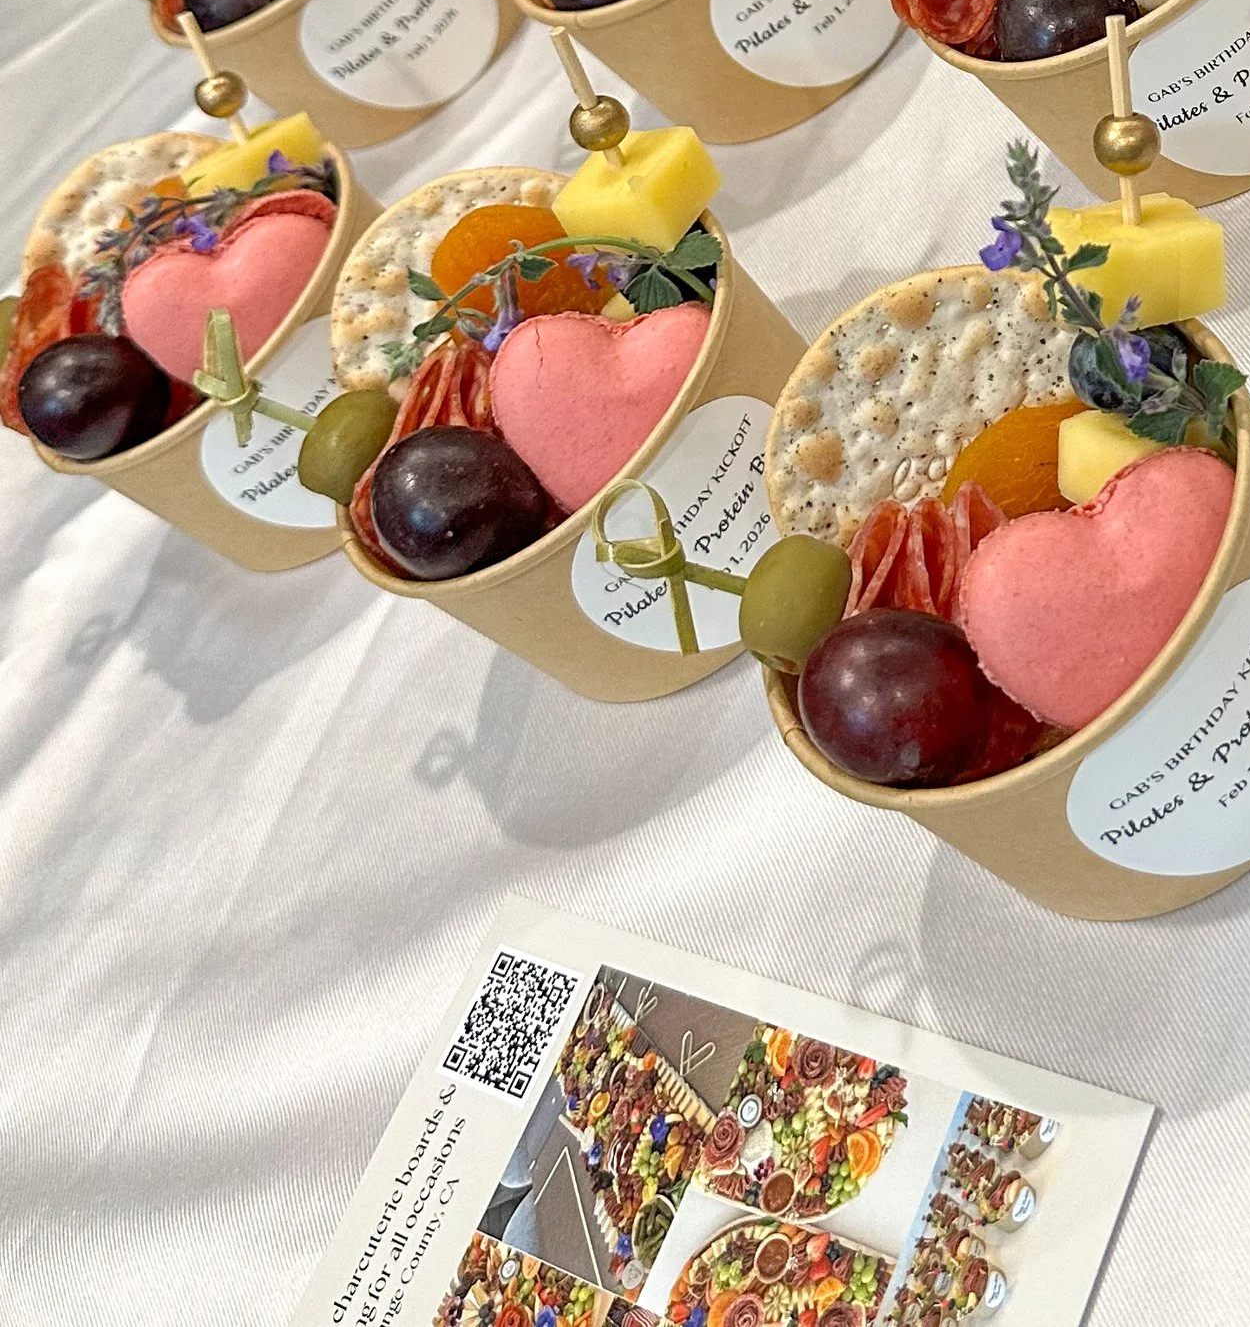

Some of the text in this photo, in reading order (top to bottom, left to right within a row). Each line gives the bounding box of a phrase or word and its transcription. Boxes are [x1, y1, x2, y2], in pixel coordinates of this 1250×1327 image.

[734, 14, 792, 54] Pilates
[1148, 76, 1193, 103] GAB'S
[1156, 101, 1209, 132] ilates
[1212, 85, 1234, 104] &
[233, 444, 274, 475] GAB'S
[674, 414, 751, 535] THDAY KICKOFF
[694, 480, 754, 555] Protein
[740, 512, 771, 554] 2026
[1109, 770, 1165, 811] GAB'S
[1164, 682, 1239, 772] BIRTHDAY
[1100, 796, 1184, 846] Pilates
[1188, 772, 1214, 792] &
[1218, 779, 1248, 808] Feb
[332, 1189, 403, 1323] charcuterie
[395, 1108, 443, 1187] boards
[439, 1083, 456, 1105] &
[368, 1117, 466, 1300] for all occasions
[400, 1212, 446, 1284] County,
[440, 1177, 460, 1205] CA
